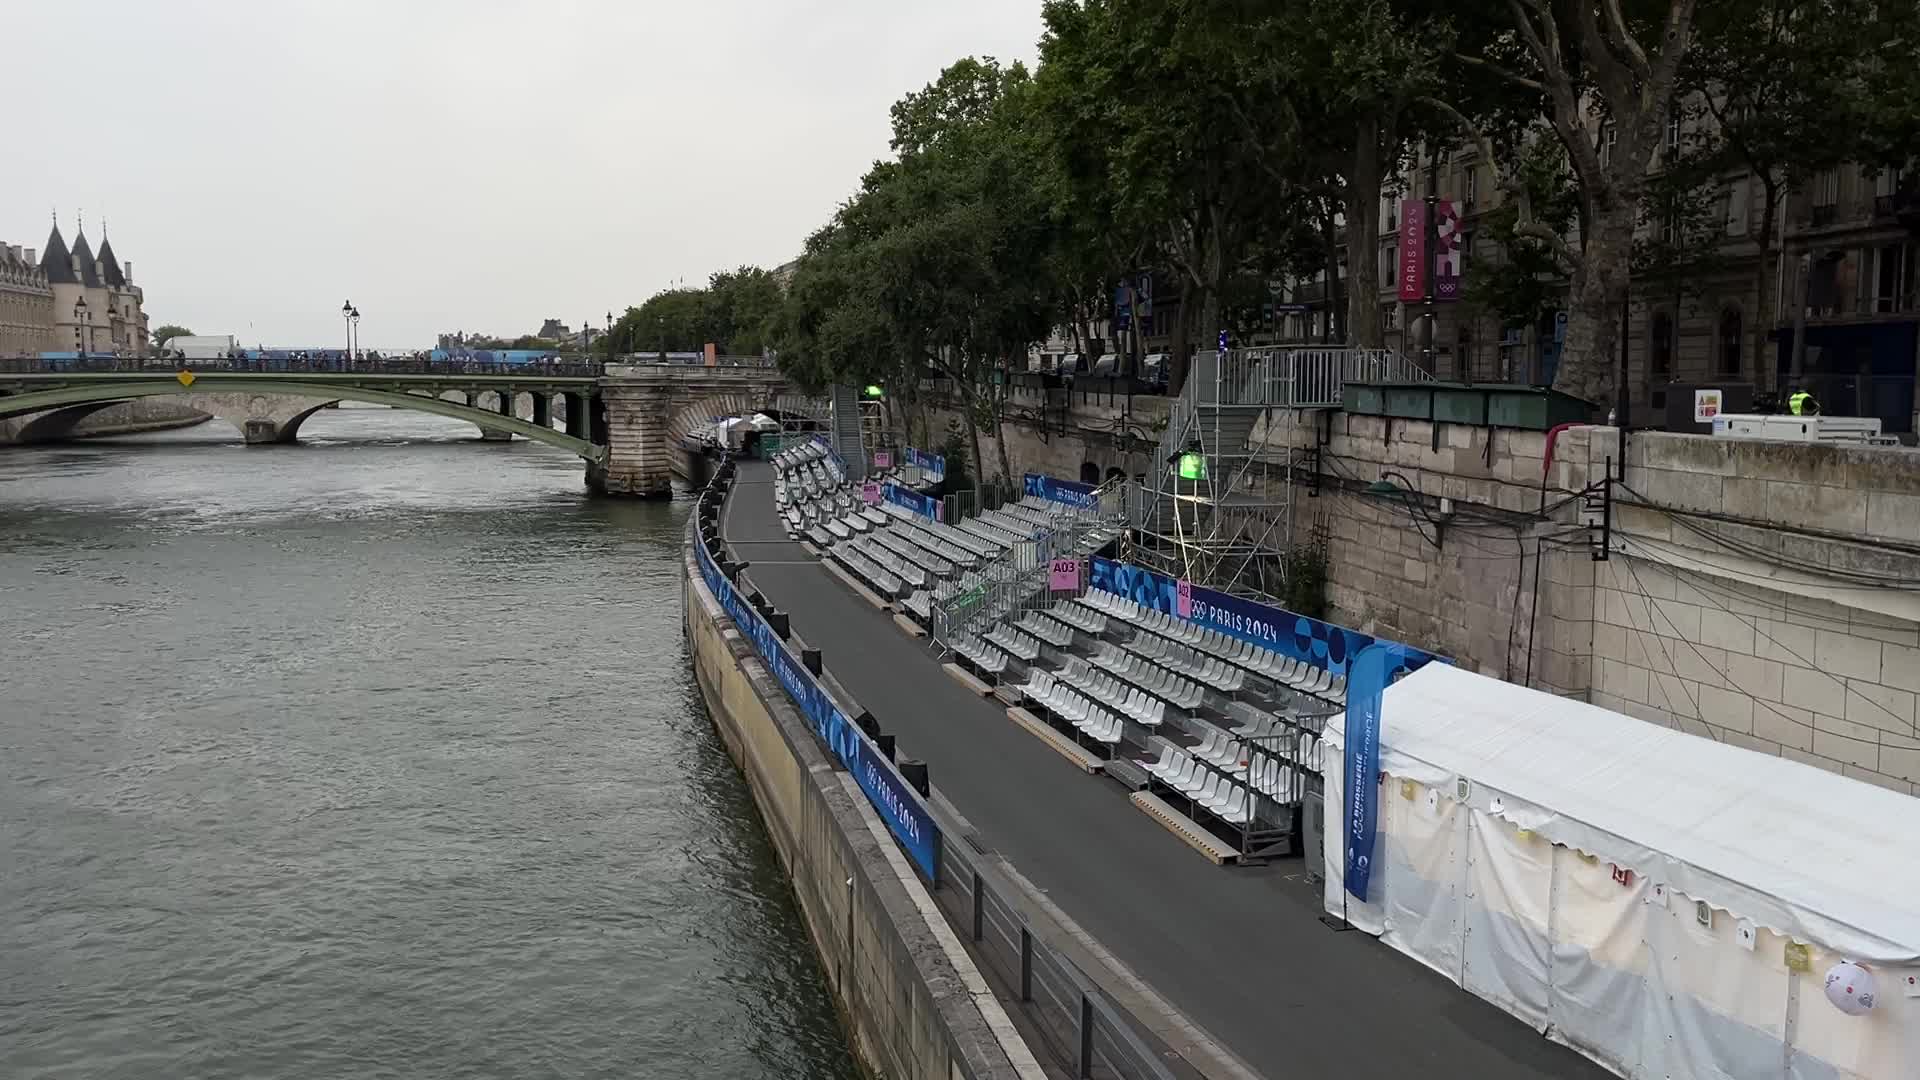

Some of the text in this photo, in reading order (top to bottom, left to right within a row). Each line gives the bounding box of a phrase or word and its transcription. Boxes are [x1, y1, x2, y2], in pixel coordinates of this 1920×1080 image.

[1406, 250, 1416, 292] PARIS
[1053, 562, 1075, 573] A03
[1178, 583, 1189, 598] A02
[1210, 605, 1277, 644] PARIS 2024
[1353, 752, 1363, 818] BRASSERIE
[878, 775, 920, 845] PARIS 2024
